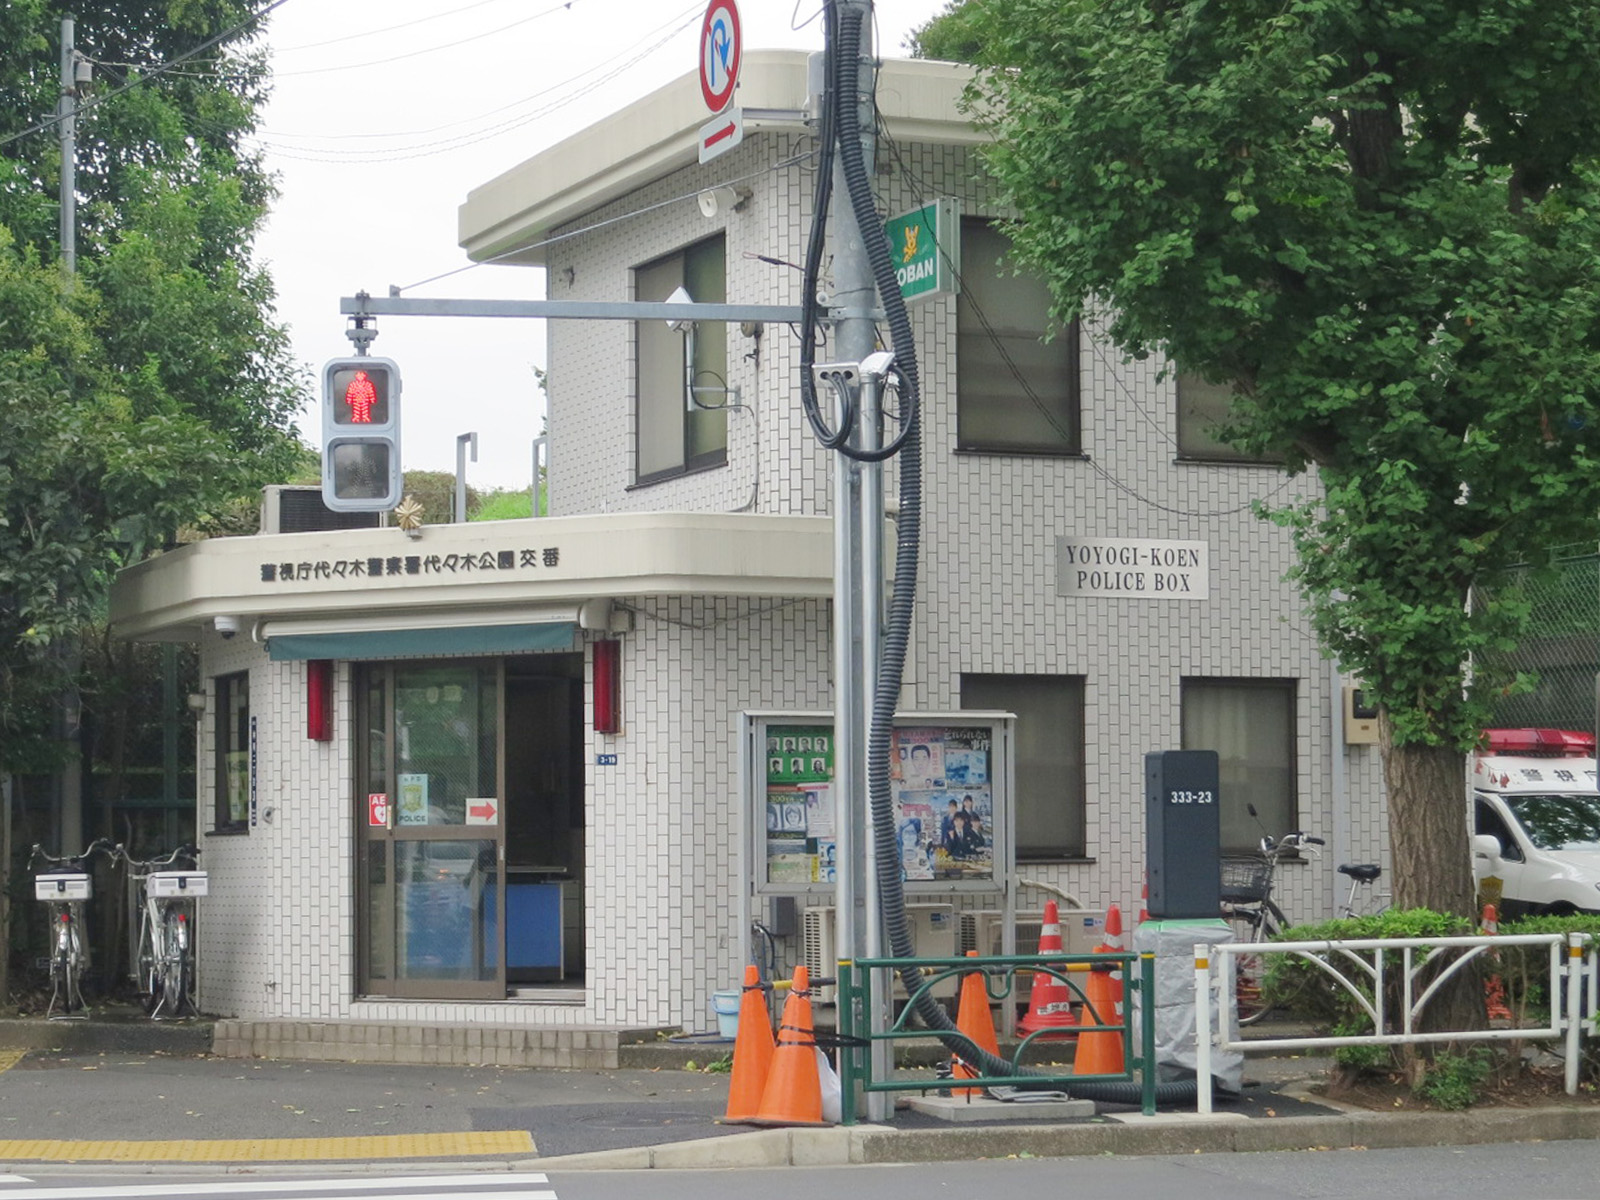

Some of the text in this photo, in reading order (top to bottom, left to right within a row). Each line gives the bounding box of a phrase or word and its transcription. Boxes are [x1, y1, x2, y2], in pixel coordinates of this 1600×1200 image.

[893, 257, 933, 287] OBAN
[1066, 545, 1200, 568] YOYOGI-KOEN
[1076, 570, 1191, 592] POLICE BOX
[371, 795, 386, 805] AE
[1170, 790, 1212, 804] 333-23
[398, 815, 426, 823] POLICE
